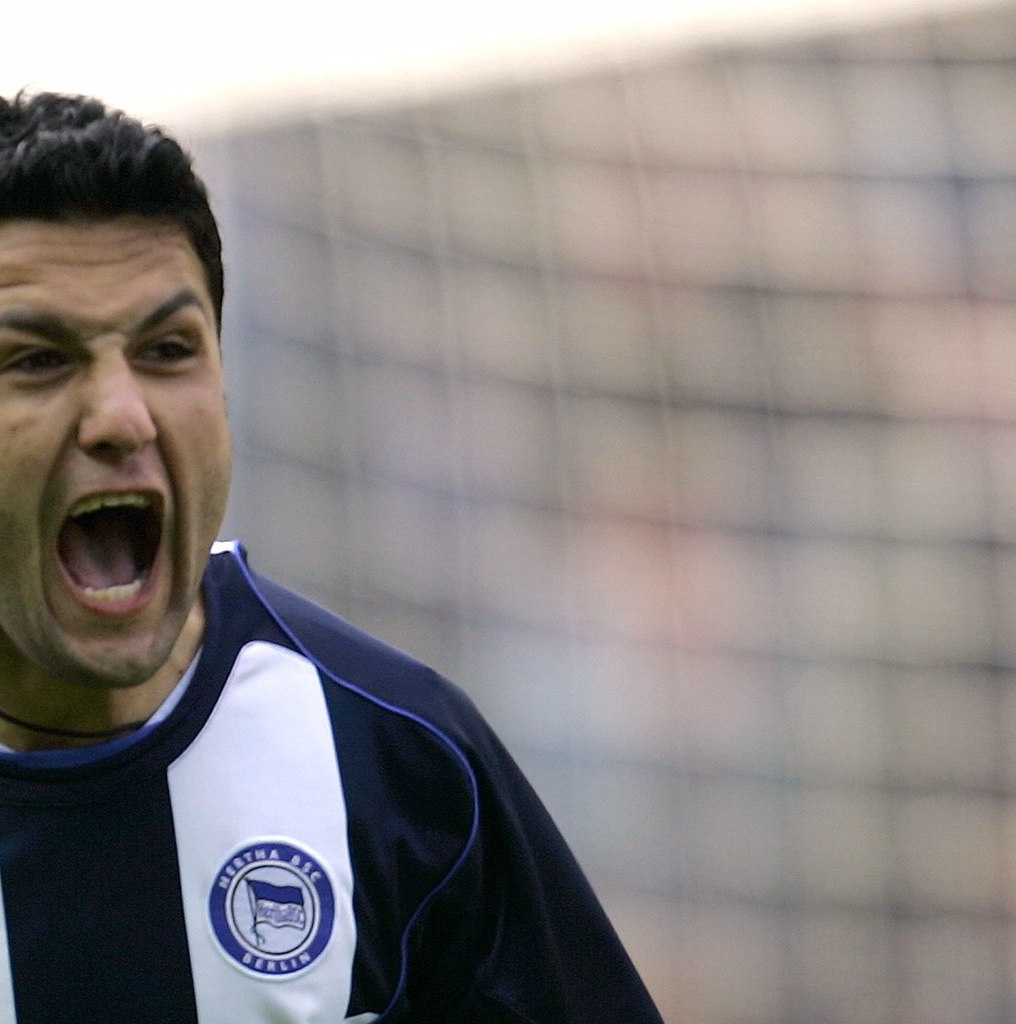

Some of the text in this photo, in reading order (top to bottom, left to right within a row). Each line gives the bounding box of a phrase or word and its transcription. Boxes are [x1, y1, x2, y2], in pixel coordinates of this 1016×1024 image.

[218, 849, 322, 889] HERTHA BSC
[242, 952, 312, 971] BERLIN
